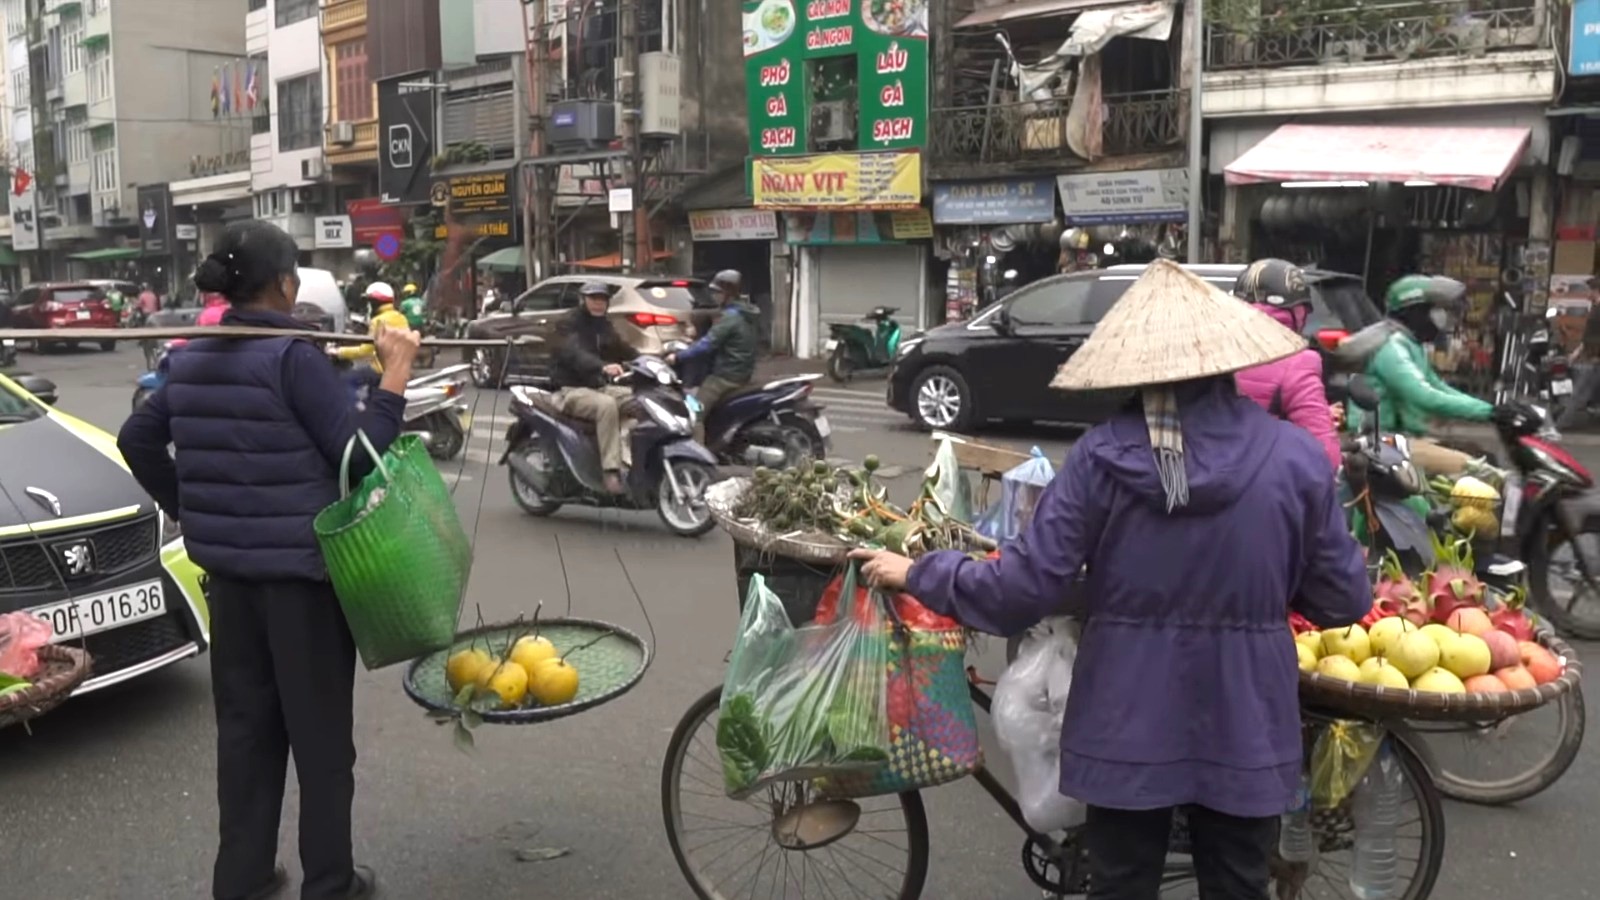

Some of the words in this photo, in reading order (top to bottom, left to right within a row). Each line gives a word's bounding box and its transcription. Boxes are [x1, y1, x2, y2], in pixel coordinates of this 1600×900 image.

[807, 26, 822, 49] GÀ
[822, 26, 852, 48] NGON
[761, 58, 790, 86] PHỞ
[767, 92, 787, 117] GÀ
[880, 79, 904, 106] GÀ
[762, 127, 795, 153] SẠCH
[873, 117, 912, 146] SẠCH
[392, 139, 410, 154] CKN
[812, 171, 848, 196] VỊT
[38, 586, 162, 636] 0F-016.36
